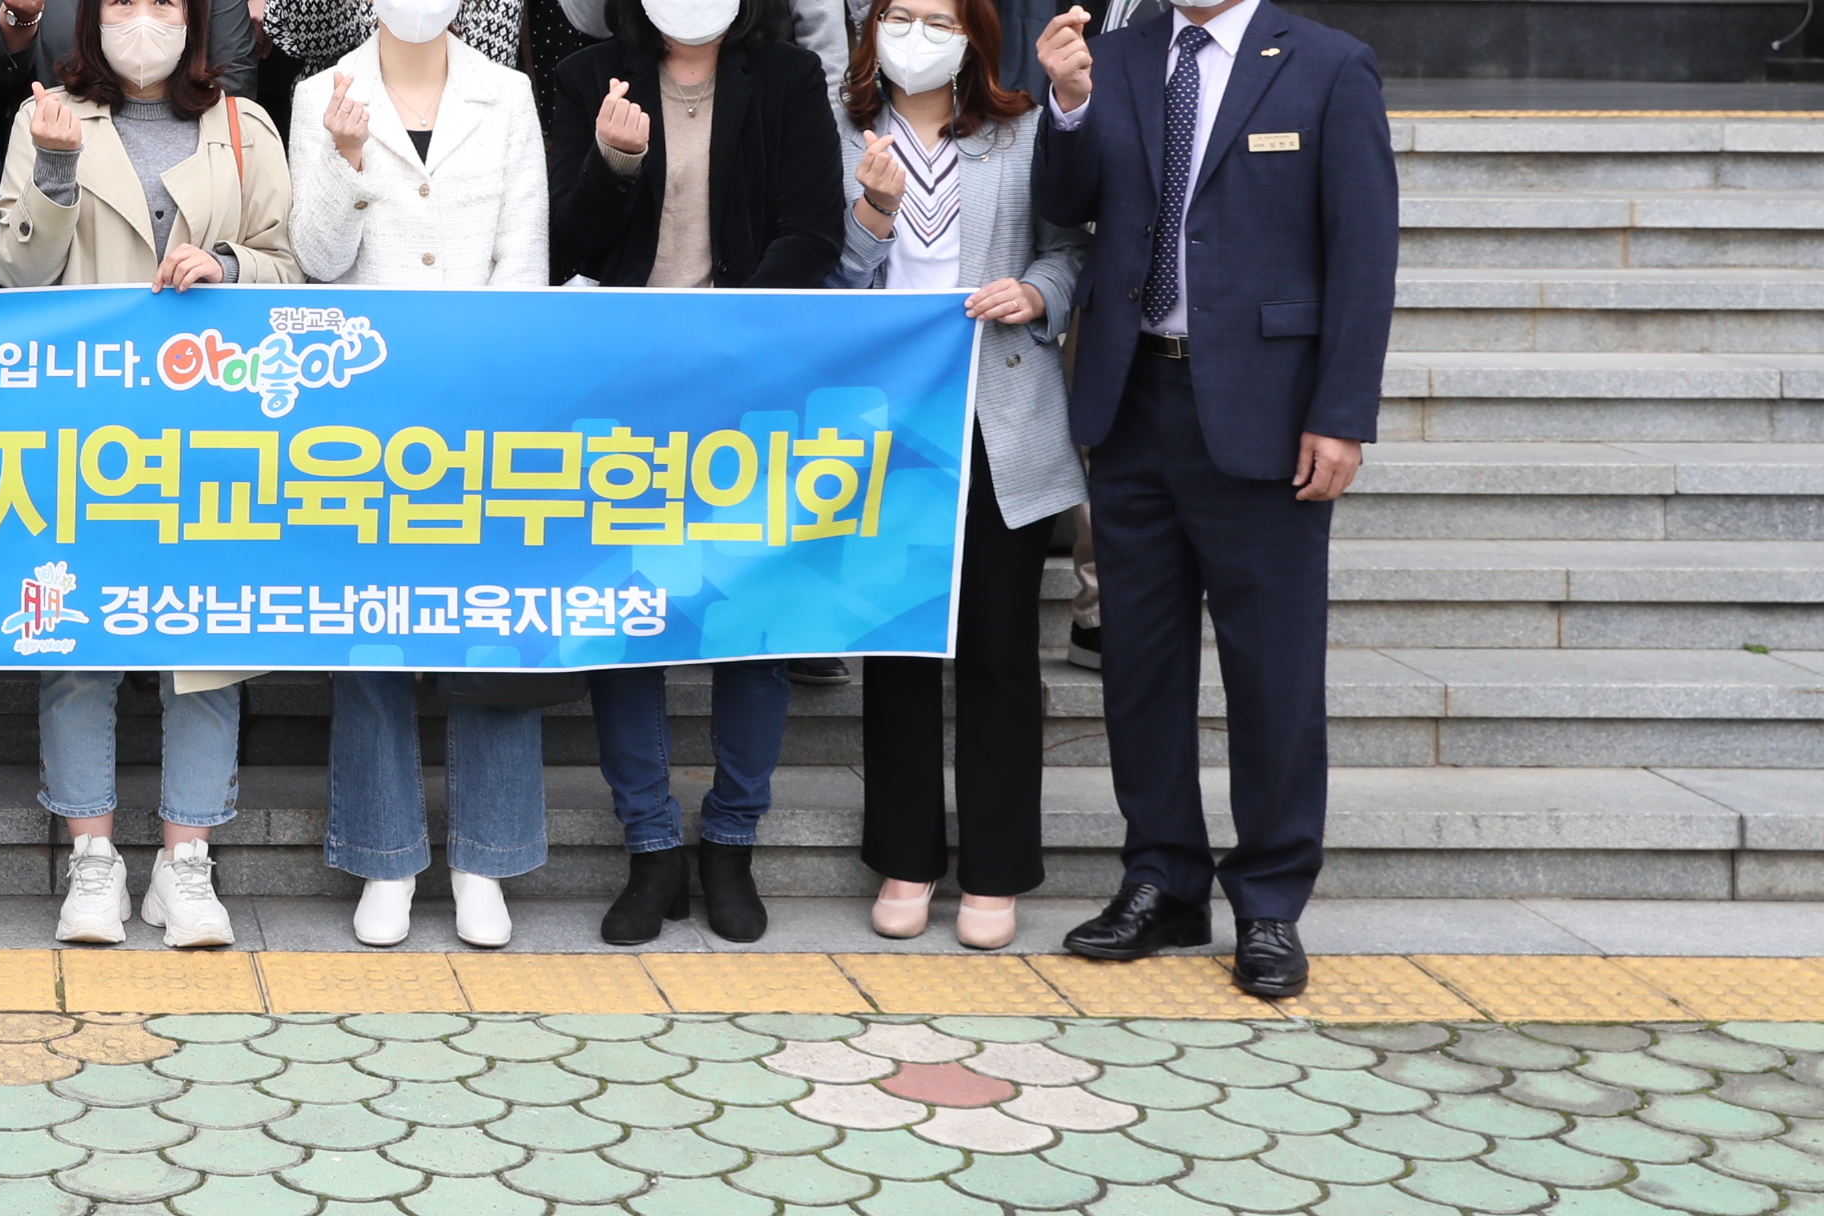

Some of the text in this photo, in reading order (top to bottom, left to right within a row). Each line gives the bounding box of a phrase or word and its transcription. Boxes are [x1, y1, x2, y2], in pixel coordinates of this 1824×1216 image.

[272, 309, 343, 332] 경남교육
[162, 333, 383, 413] 아이좋아
[100, 584, 667, 637] 경상남도남해교육지원청
